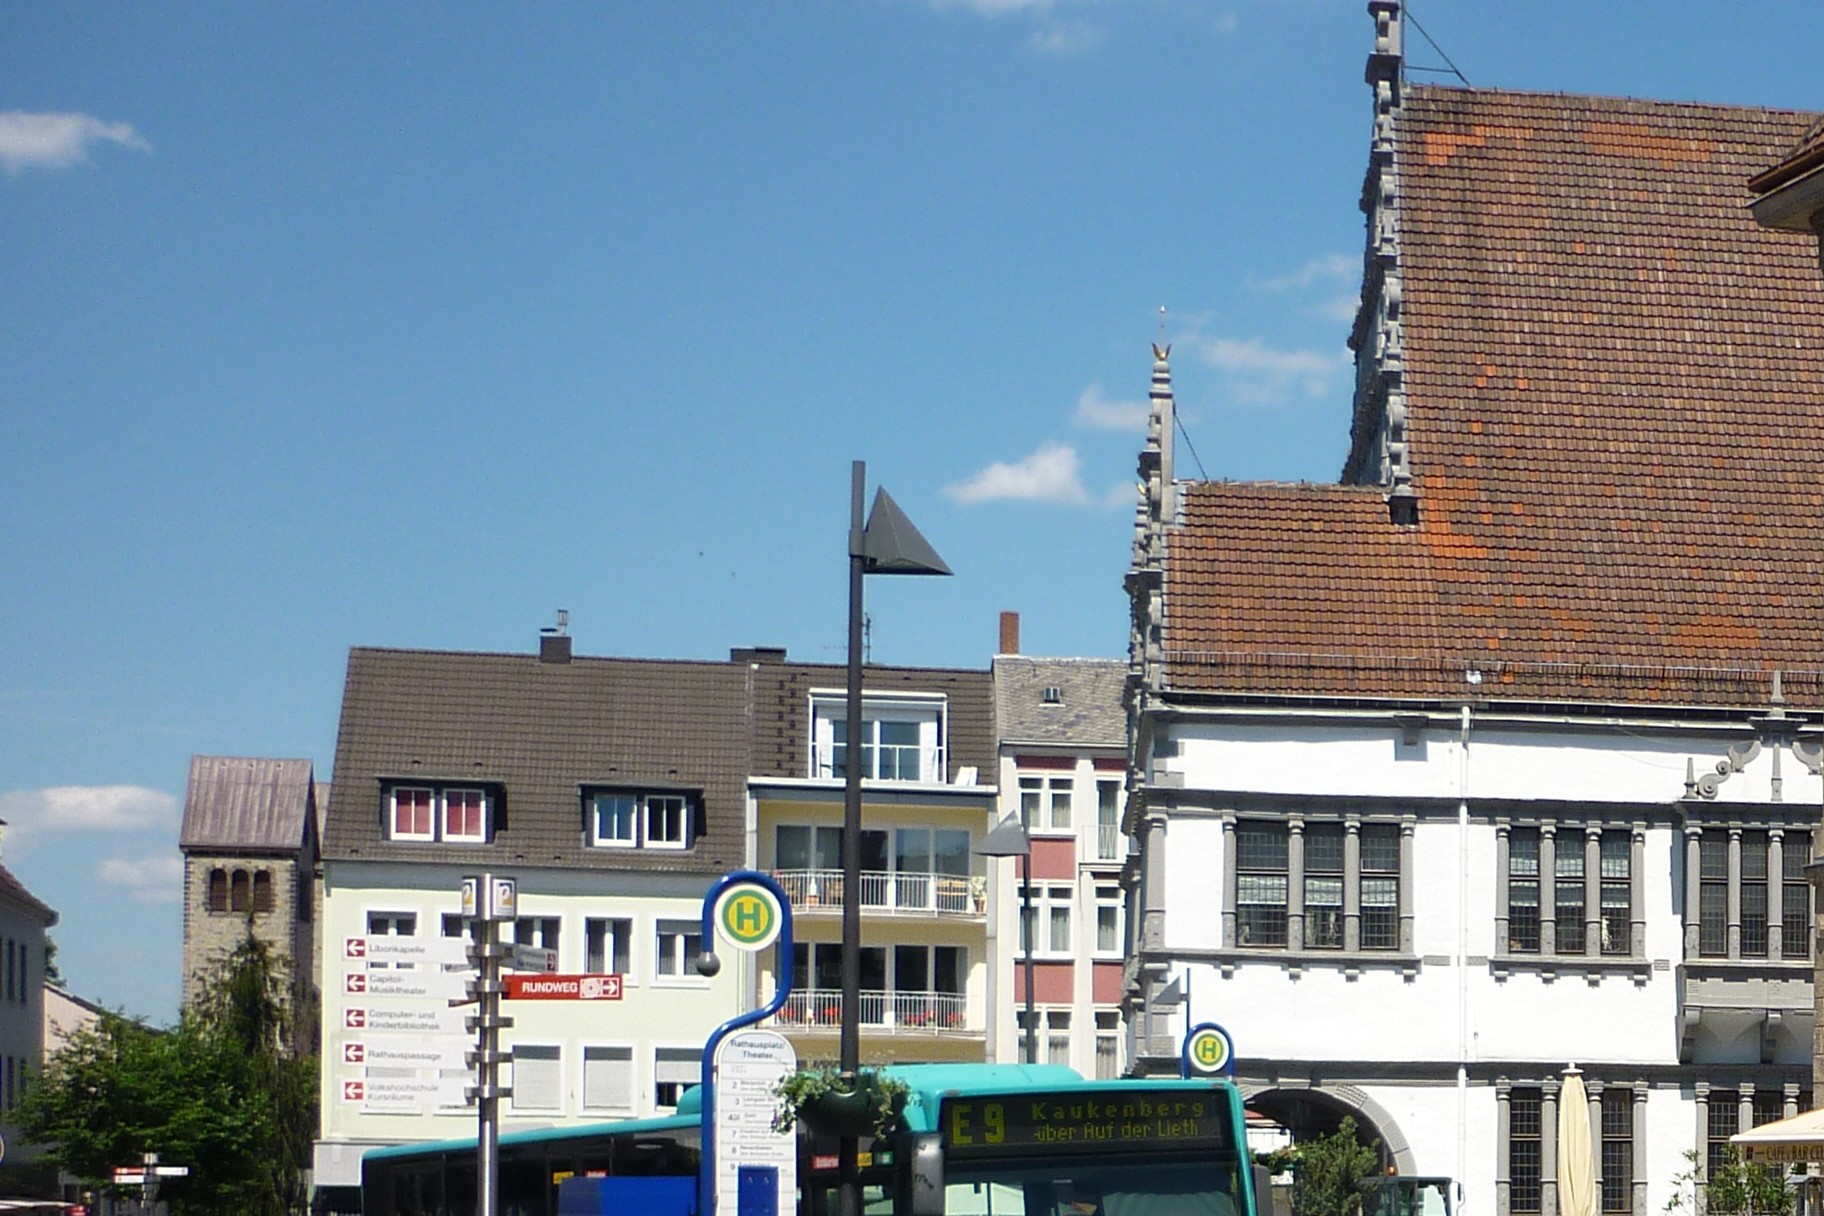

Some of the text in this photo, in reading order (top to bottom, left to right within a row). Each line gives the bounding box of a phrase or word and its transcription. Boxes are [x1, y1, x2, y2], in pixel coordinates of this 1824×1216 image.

[369, 944, 426, 955] Liborikapelle
[369, 986, 427, 995] Musiktheater
[522, 982, 578, 993] RUNDWEG
[369, 1009, 435, 1020] Computer- und
[369, 1021, 440, 1030] Kinderbibliothek
[368, 1049, 441, 1061] Rathauspassage
[743, 1050, 773, 1059] Theater
[367, 1083, 439, 1093] Volkshochschule
[1032, 1100, 1205, 1120] Kaukenberg
[1121, 1120, 1151, 1138] der
[1158, 1118, 1198, 1137] Lieth
[1792, 1145, 1808, 1160] BAR
